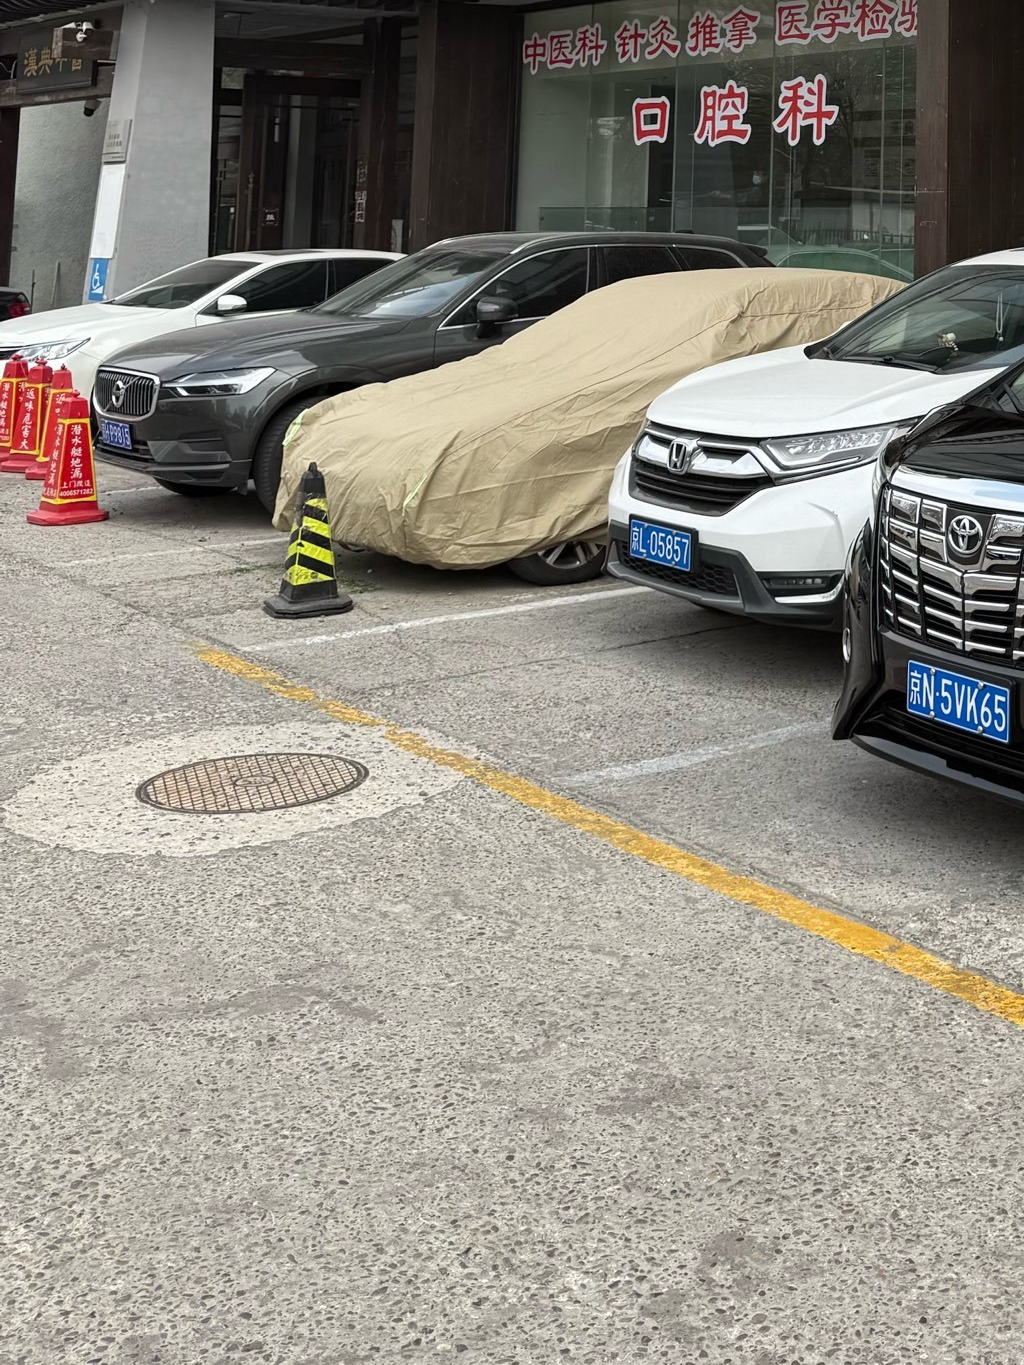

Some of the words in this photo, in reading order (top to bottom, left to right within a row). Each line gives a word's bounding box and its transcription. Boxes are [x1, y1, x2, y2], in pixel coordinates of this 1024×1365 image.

[523, 31, 604, 72] 中医科
[616, 19, 679, 62] 针灸
[688, 9, 760, 56] 推拿
[631, 73, 840, 147] 口腔科
[70, 424, 83, 479] 潜水艇地漏
[909, 669, 1007, 733] 京N·5VK65
